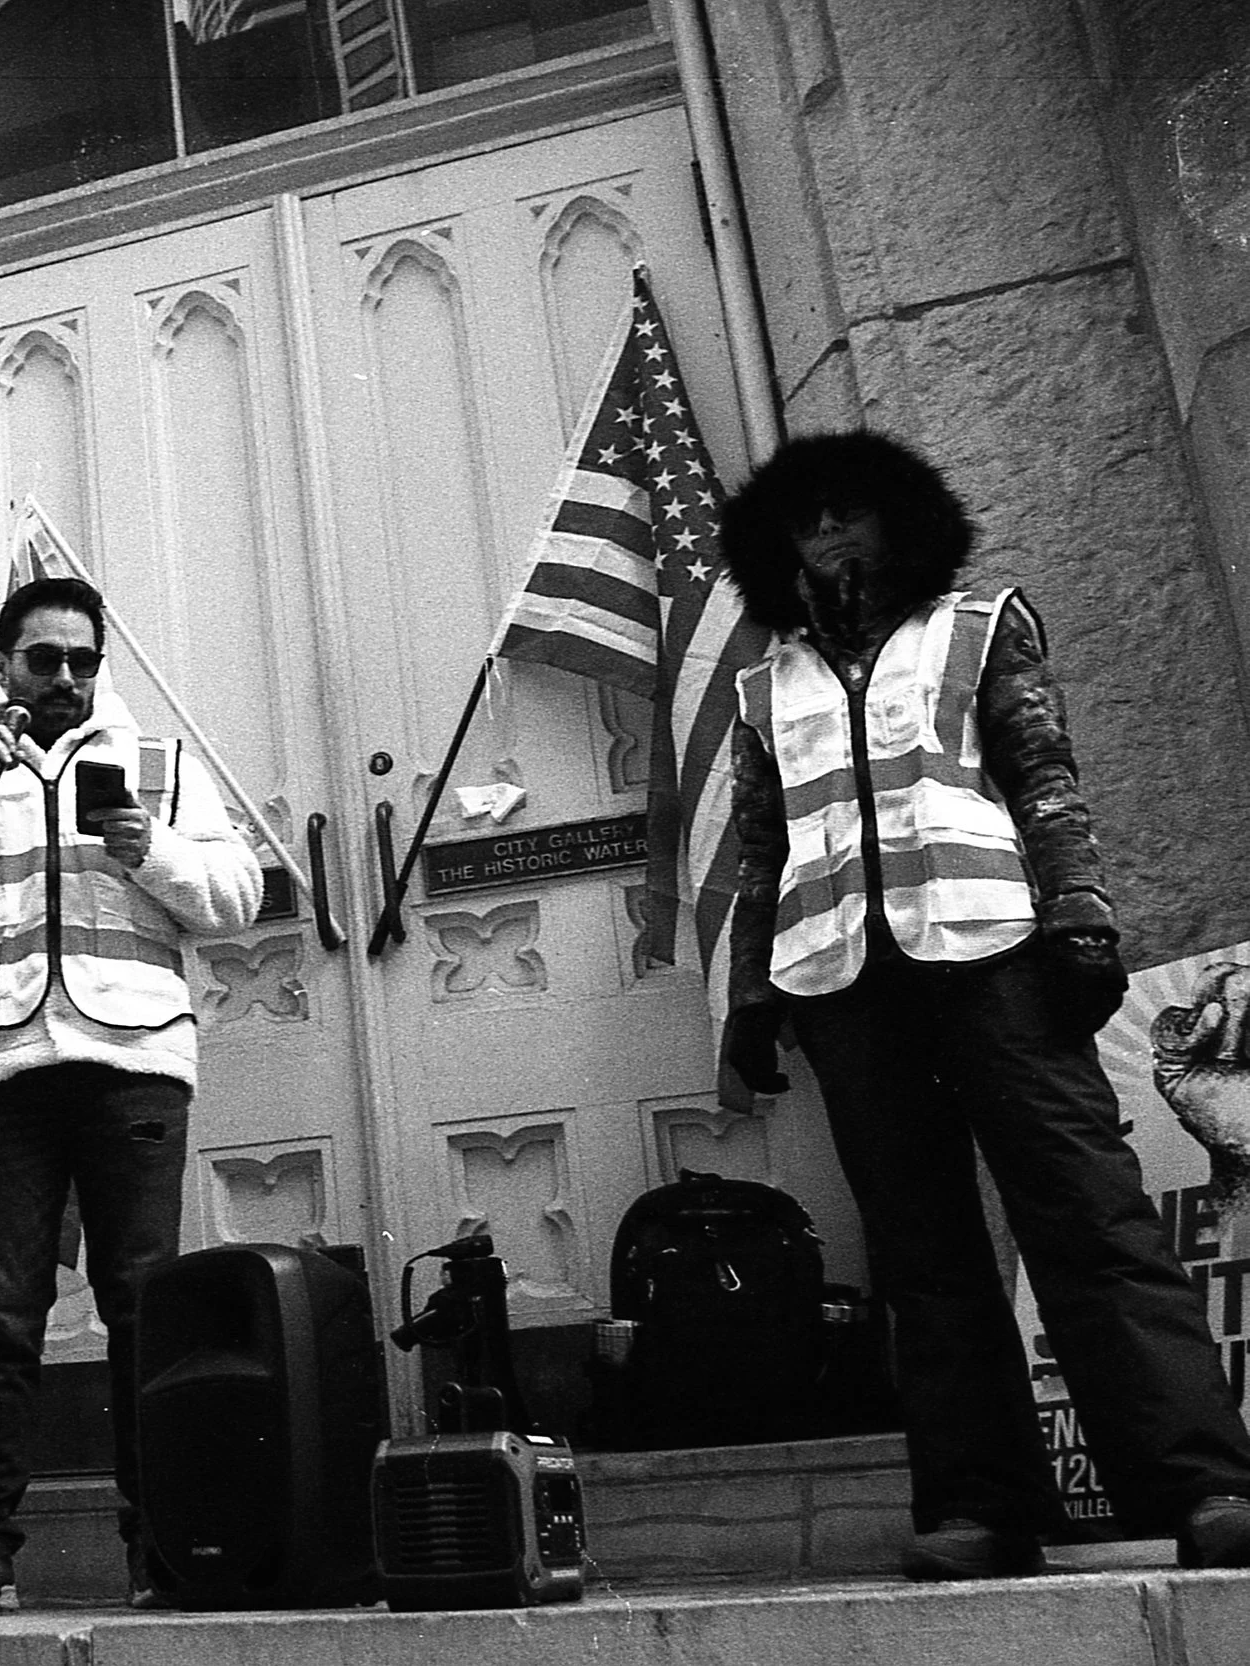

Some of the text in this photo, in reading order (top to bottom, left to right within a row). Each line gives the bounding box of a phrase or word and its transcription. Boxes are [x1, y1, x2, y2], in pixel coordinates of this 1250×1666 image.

[494, 824, 634, 857] CITY GALLERY
[437, 839, 649, 883] THE HISTORIC WATER
